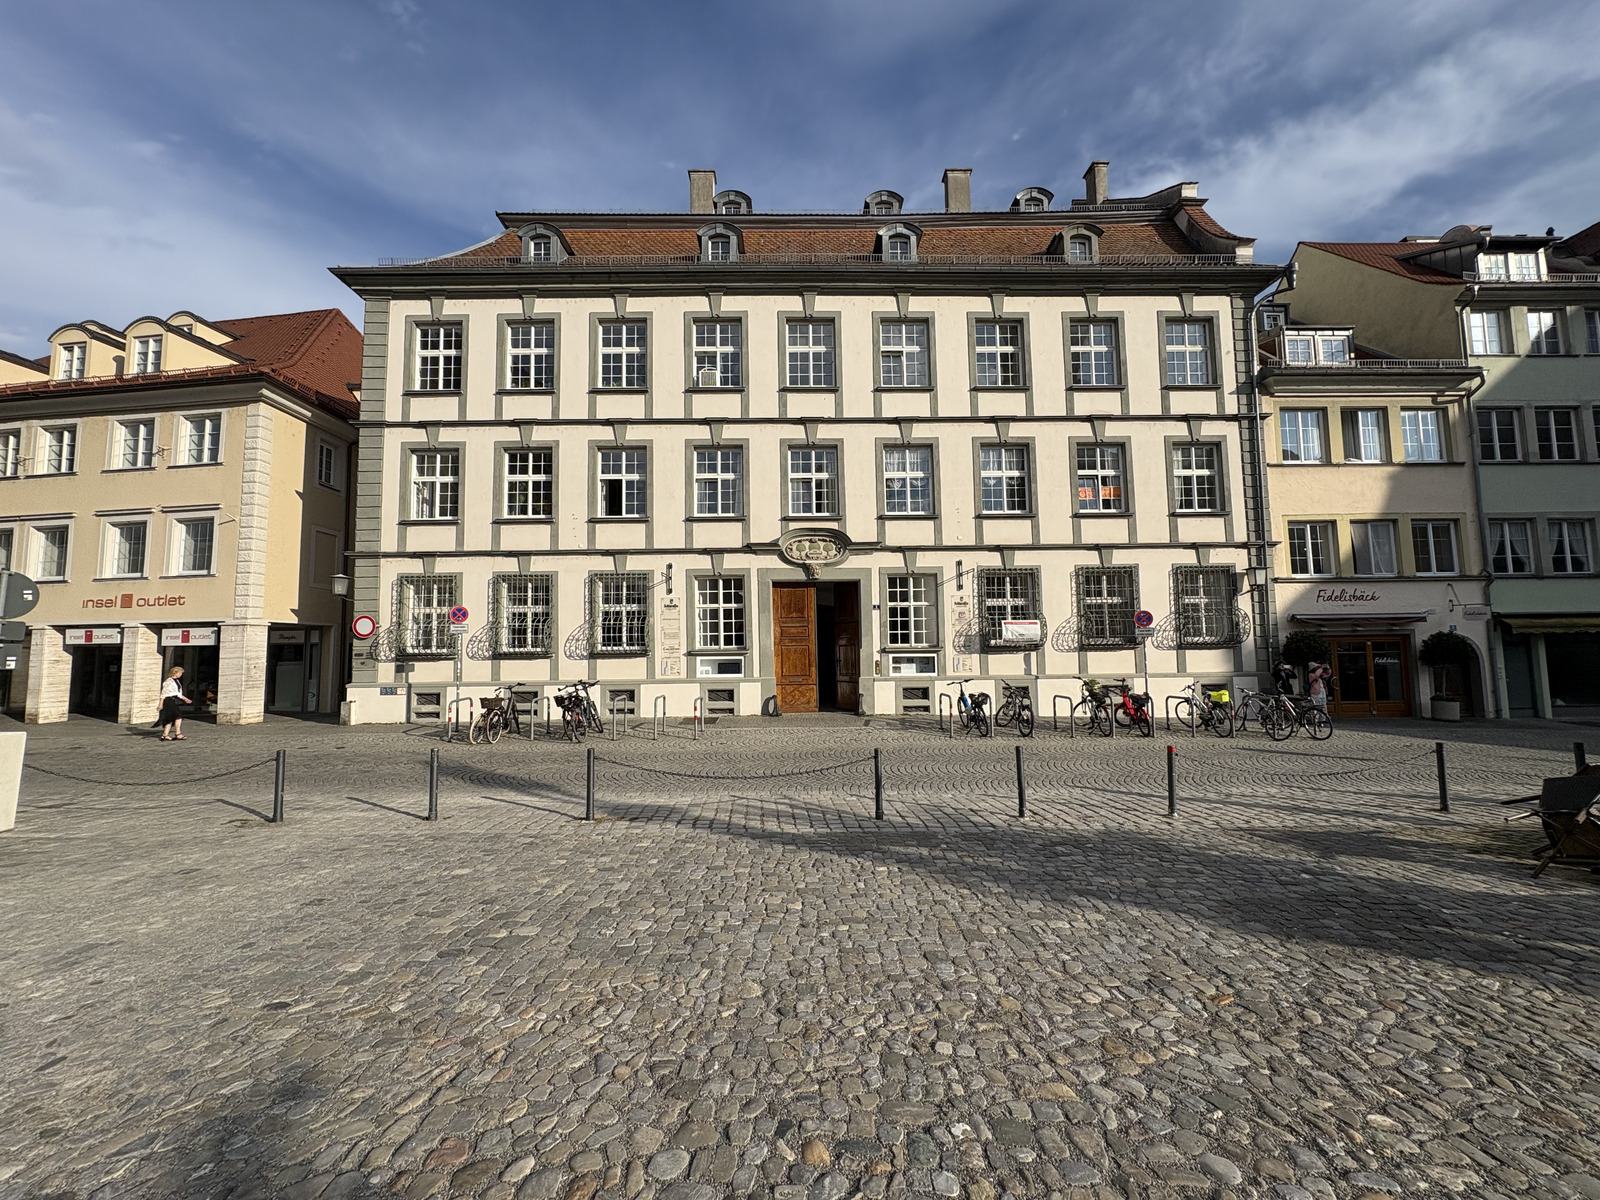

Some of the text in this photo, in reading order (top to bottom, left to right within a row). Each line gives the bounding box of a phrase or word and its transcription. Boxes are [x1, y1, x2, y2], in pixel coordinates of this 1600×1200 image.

[82, 594, 186, 608] insel outlet
[1316, 588, 1380, 603] Fidelisbäck
